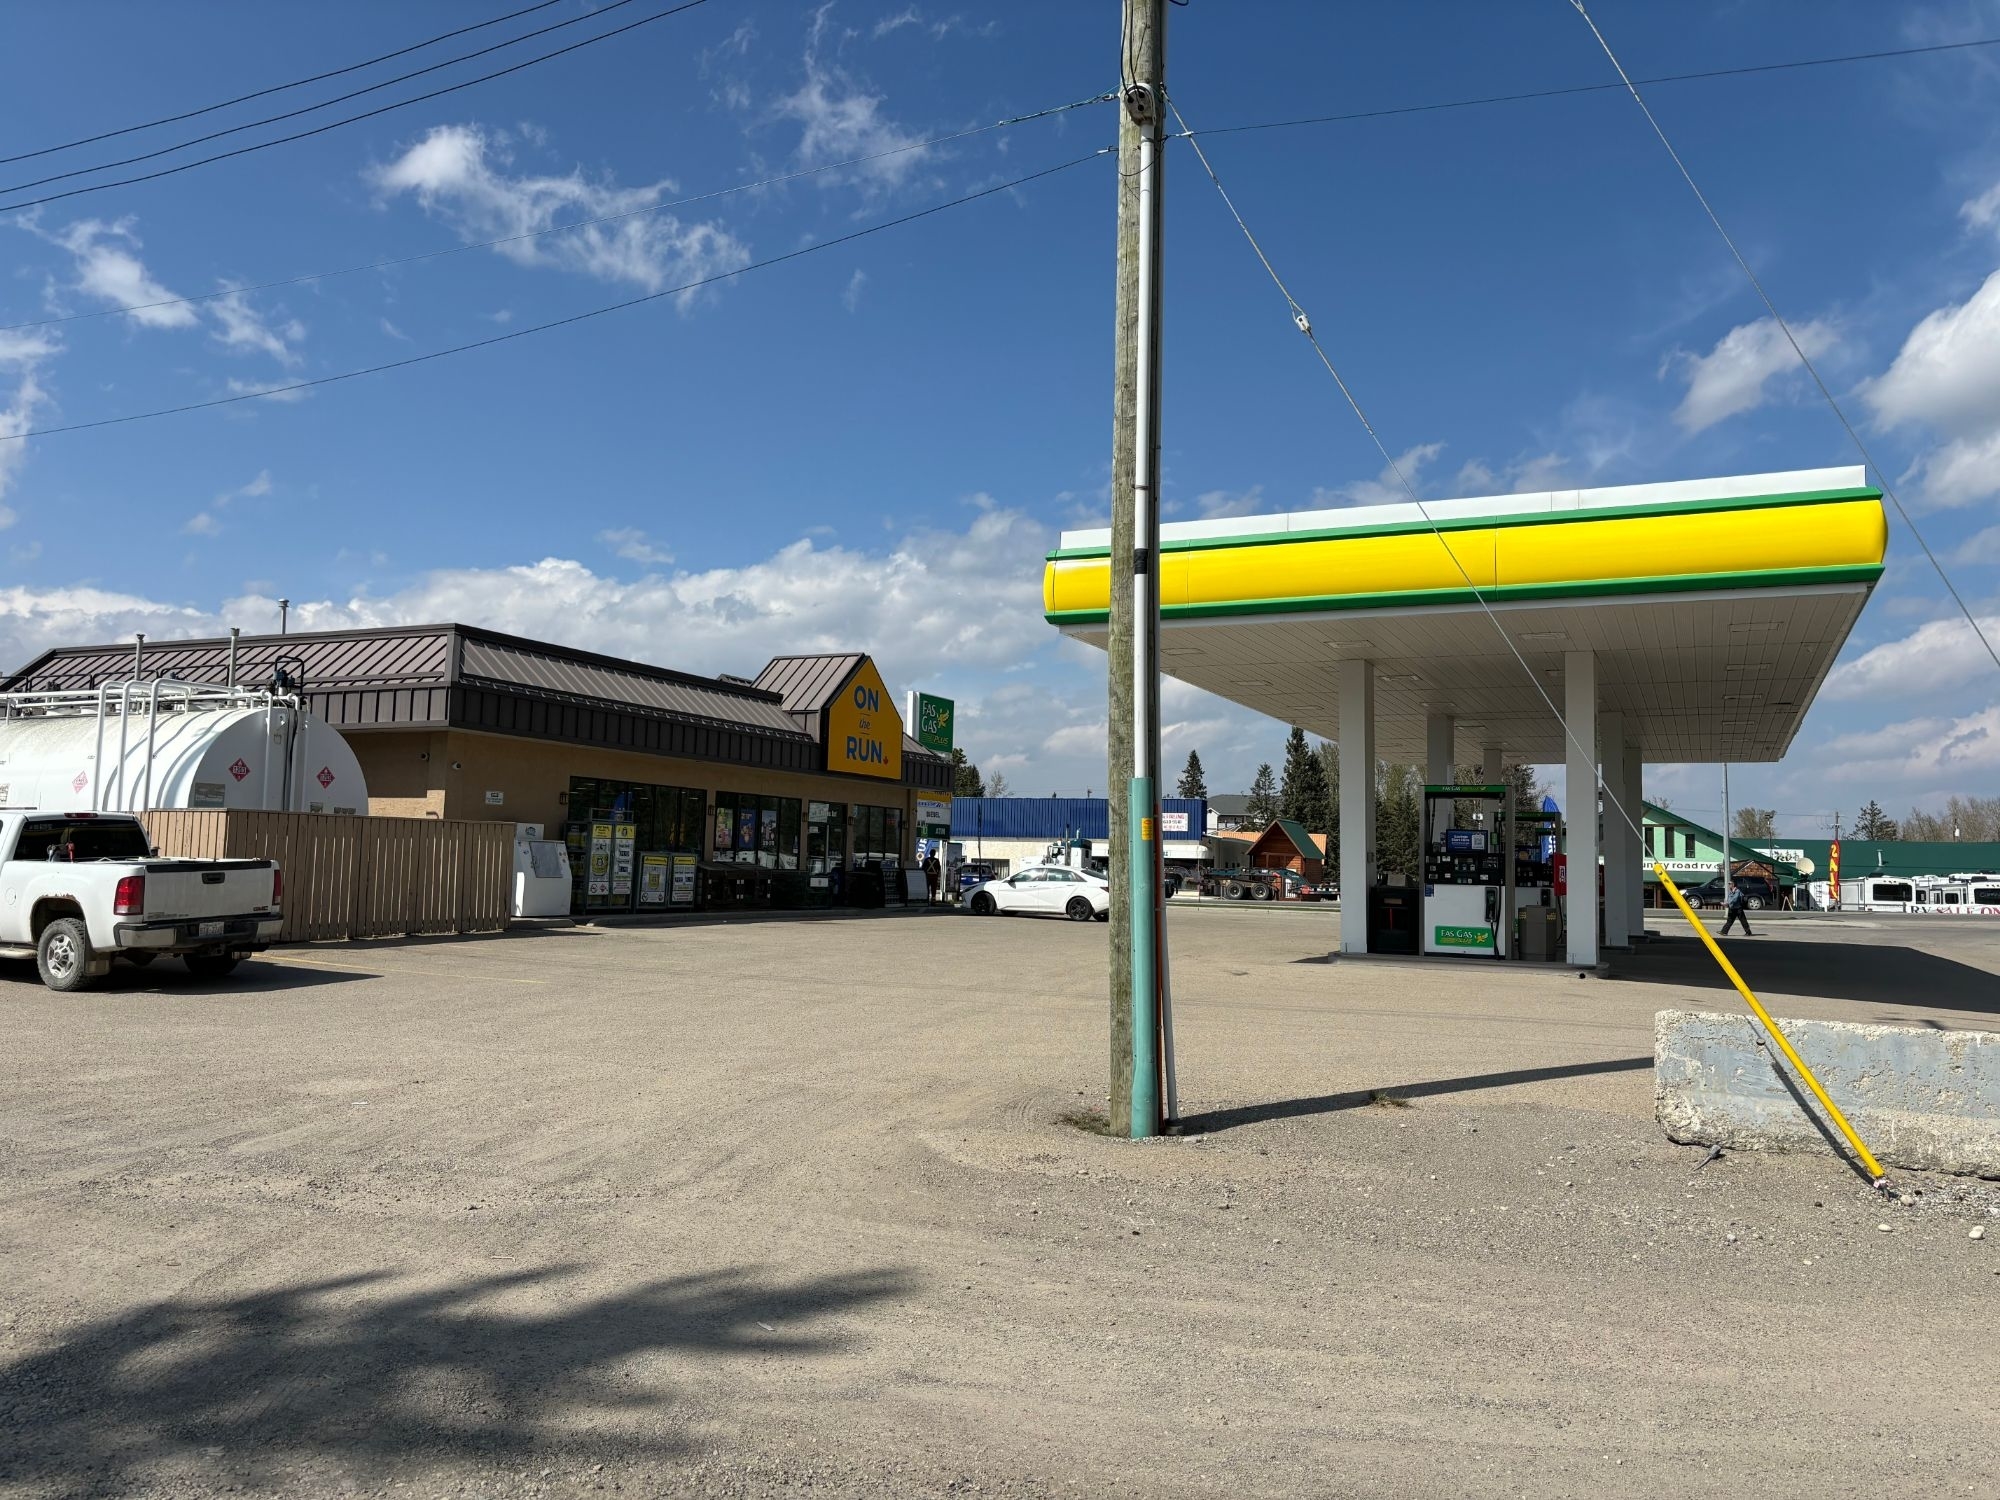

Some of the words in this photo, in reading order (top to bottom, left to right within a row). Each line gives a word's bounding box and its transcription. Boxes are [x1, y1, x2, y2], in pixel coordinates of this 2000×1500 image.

[854, 685, 879, 713] ON
[922, 701, 936, 717] FAS
[859, 719, 871, 730] the
[921, 716, 937, 733] GAS
[933, 736, 949, 745] PLUS
[846, 736, 882, 764] RUN
[935, 827, 946, 835] ATM
[1672, 861, 1699, 869] road
[1910, 905, 1932, 914] RV
[1456, 930, 1473, 938] GAS
